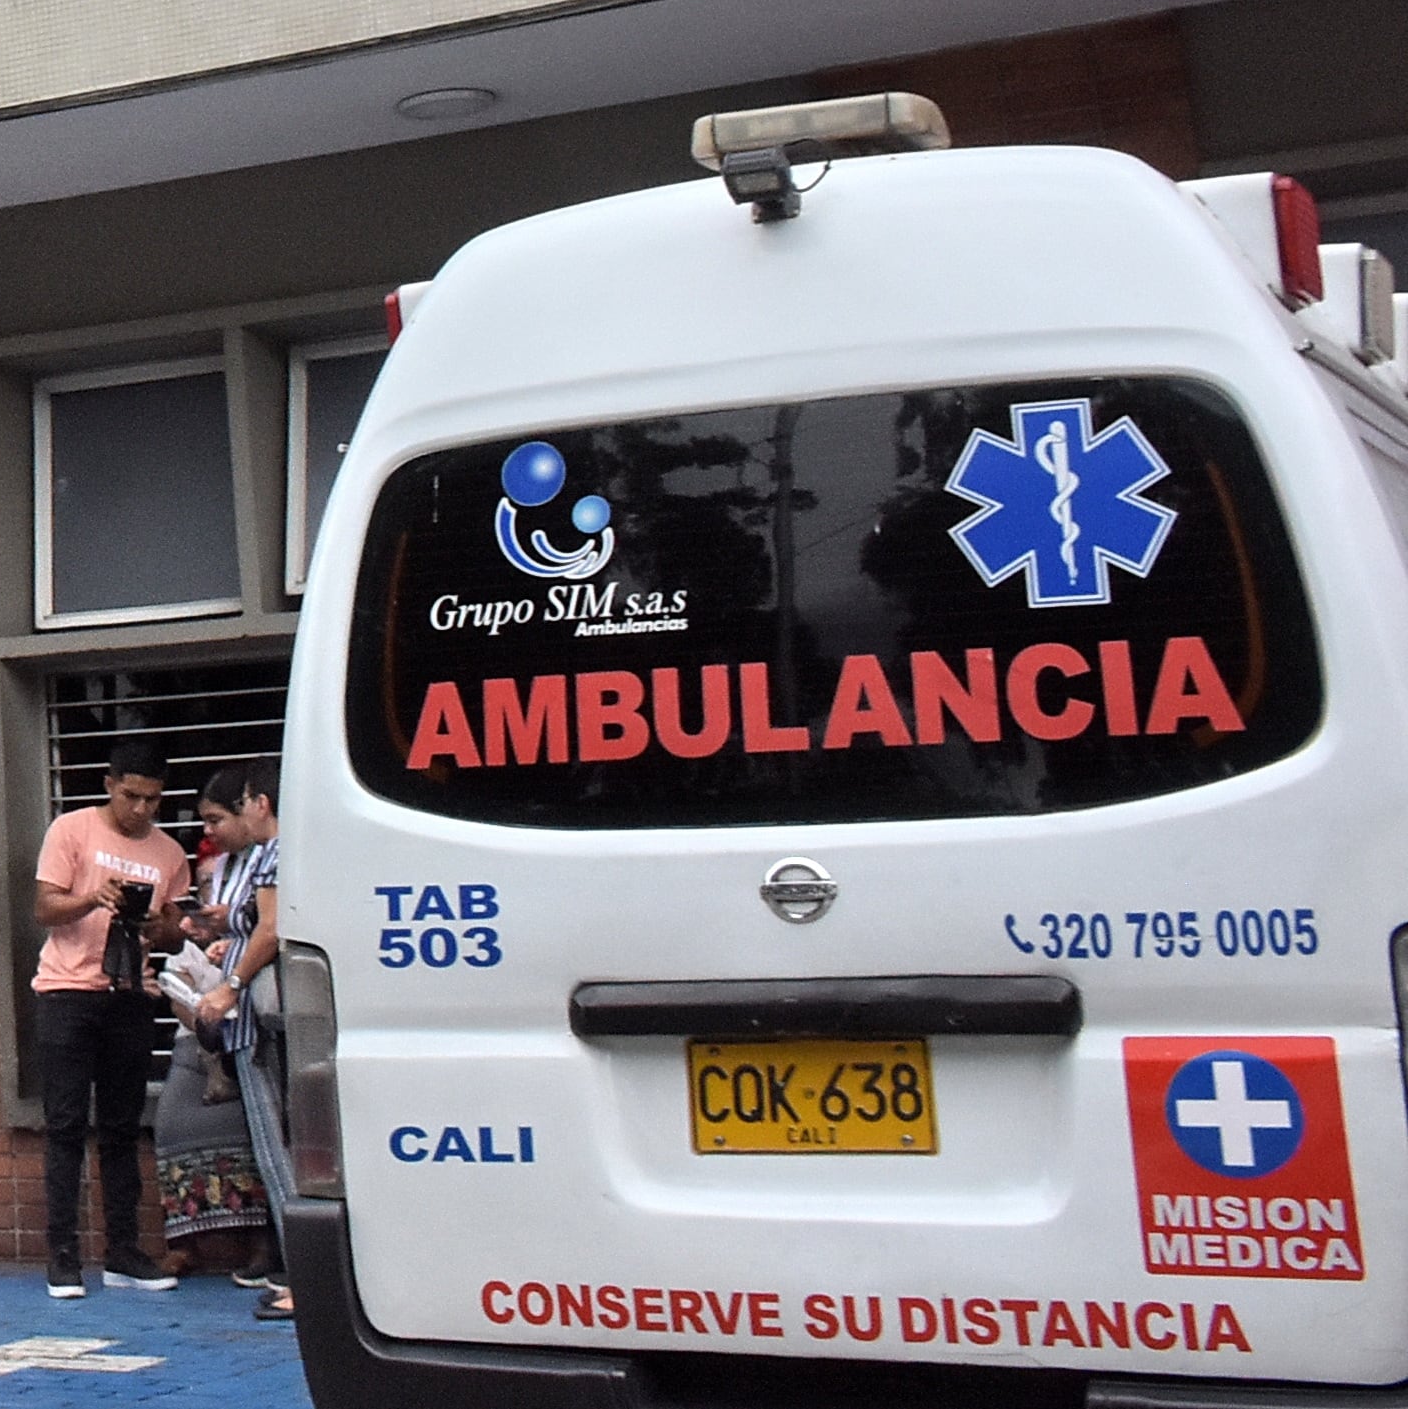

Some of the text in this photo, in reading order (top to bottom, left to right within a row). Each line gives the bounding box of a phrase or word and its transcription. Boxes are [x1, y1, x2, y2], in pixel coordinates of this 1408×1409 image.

[430, 581, 688, 636] Grupo SIM s.a.s
[574, 615, 688, 637] Ambulancias
[406, 636, 1247, 771] AMBULANCIA
[374, 884, 500, 922] TAB
[379, 927, 502, 968] 503
[1040, 909, 1319, 959] 320 795 0005
[699, 1063, 923, 1123] CQK 638
[389, 1126, 535, 1163] CALI
[787, 1127, 837, 1144] CALI
[1152, 1194, 1346, 1232] MISION
[1148, 1232, 1362, 1272] MEDICA
[481, 1280, 1253, 1353] CONSERVE SU DISTANCIA
